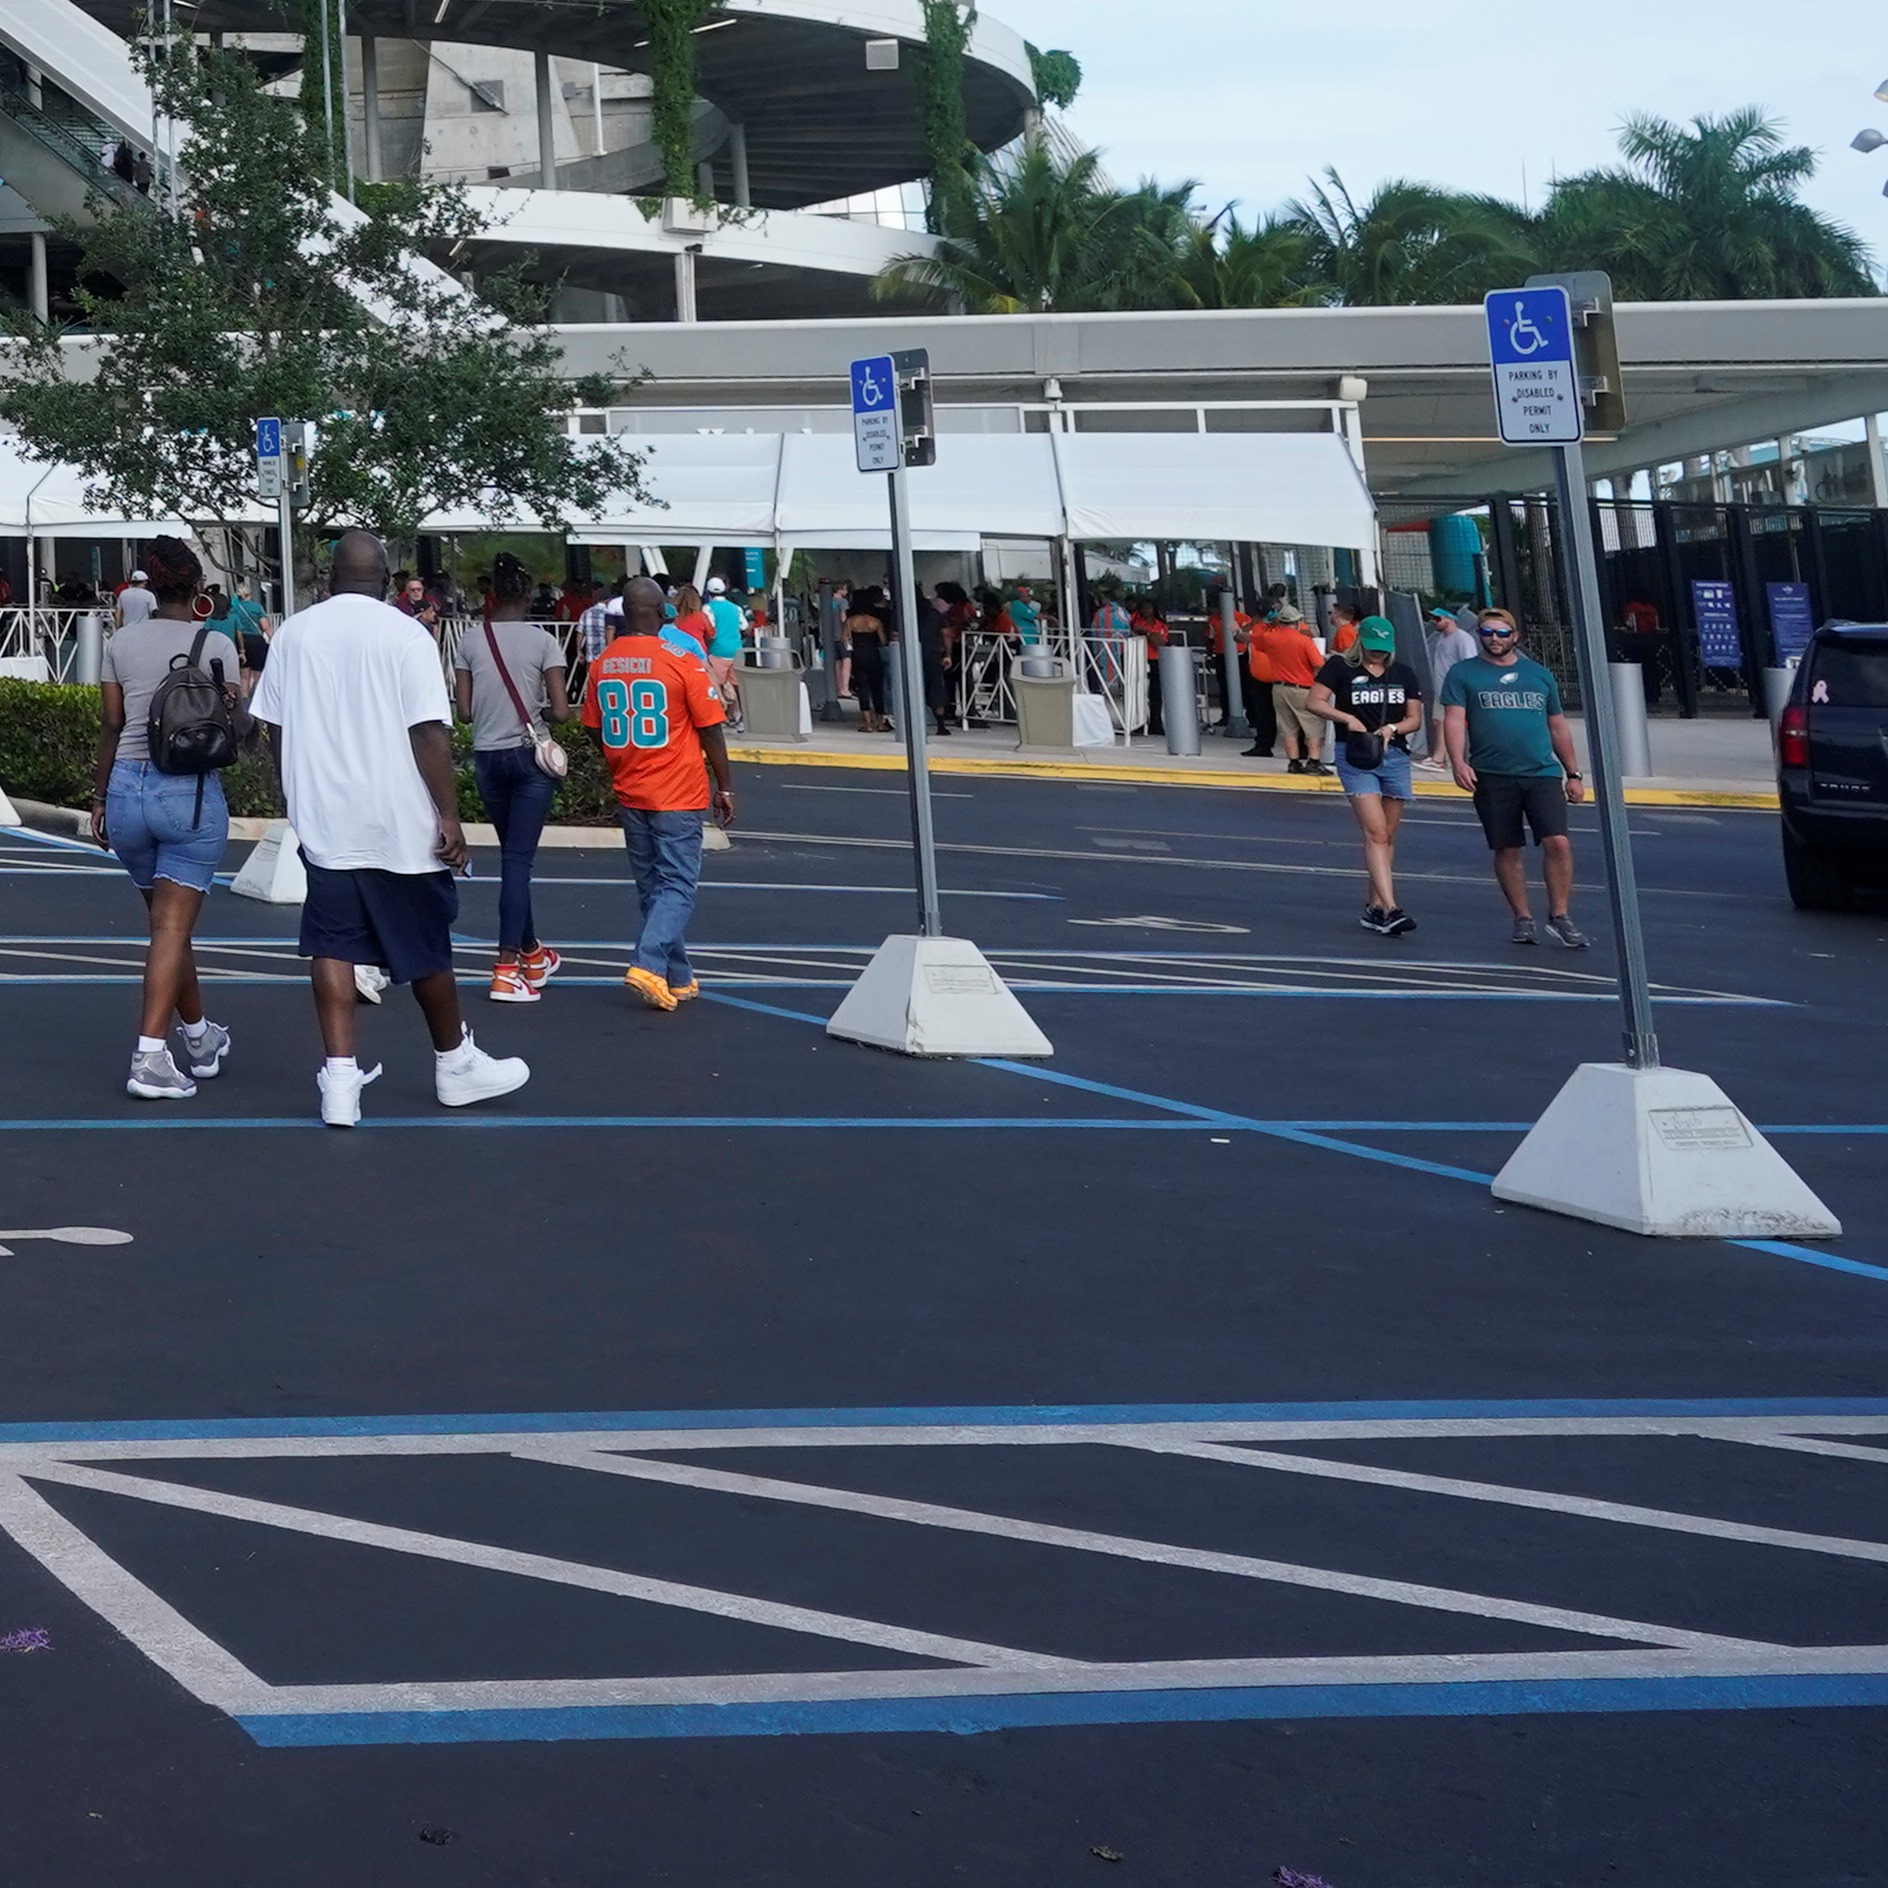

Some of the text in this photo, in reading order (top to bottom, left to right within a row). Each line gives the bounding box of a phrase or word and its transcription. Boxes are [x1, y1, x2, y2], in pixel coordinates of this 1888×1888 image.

[1508, 369, 1558, 381] PARKING BY
[1516, 388, 1555, 399] DISABLED
[1523, 405, 1552, 416] PERMIT
[1529, 423, 1550, 434] ONLY
[1478, 691, 1546, 711] EAGLES
[597, 678, 670, 749] 88
